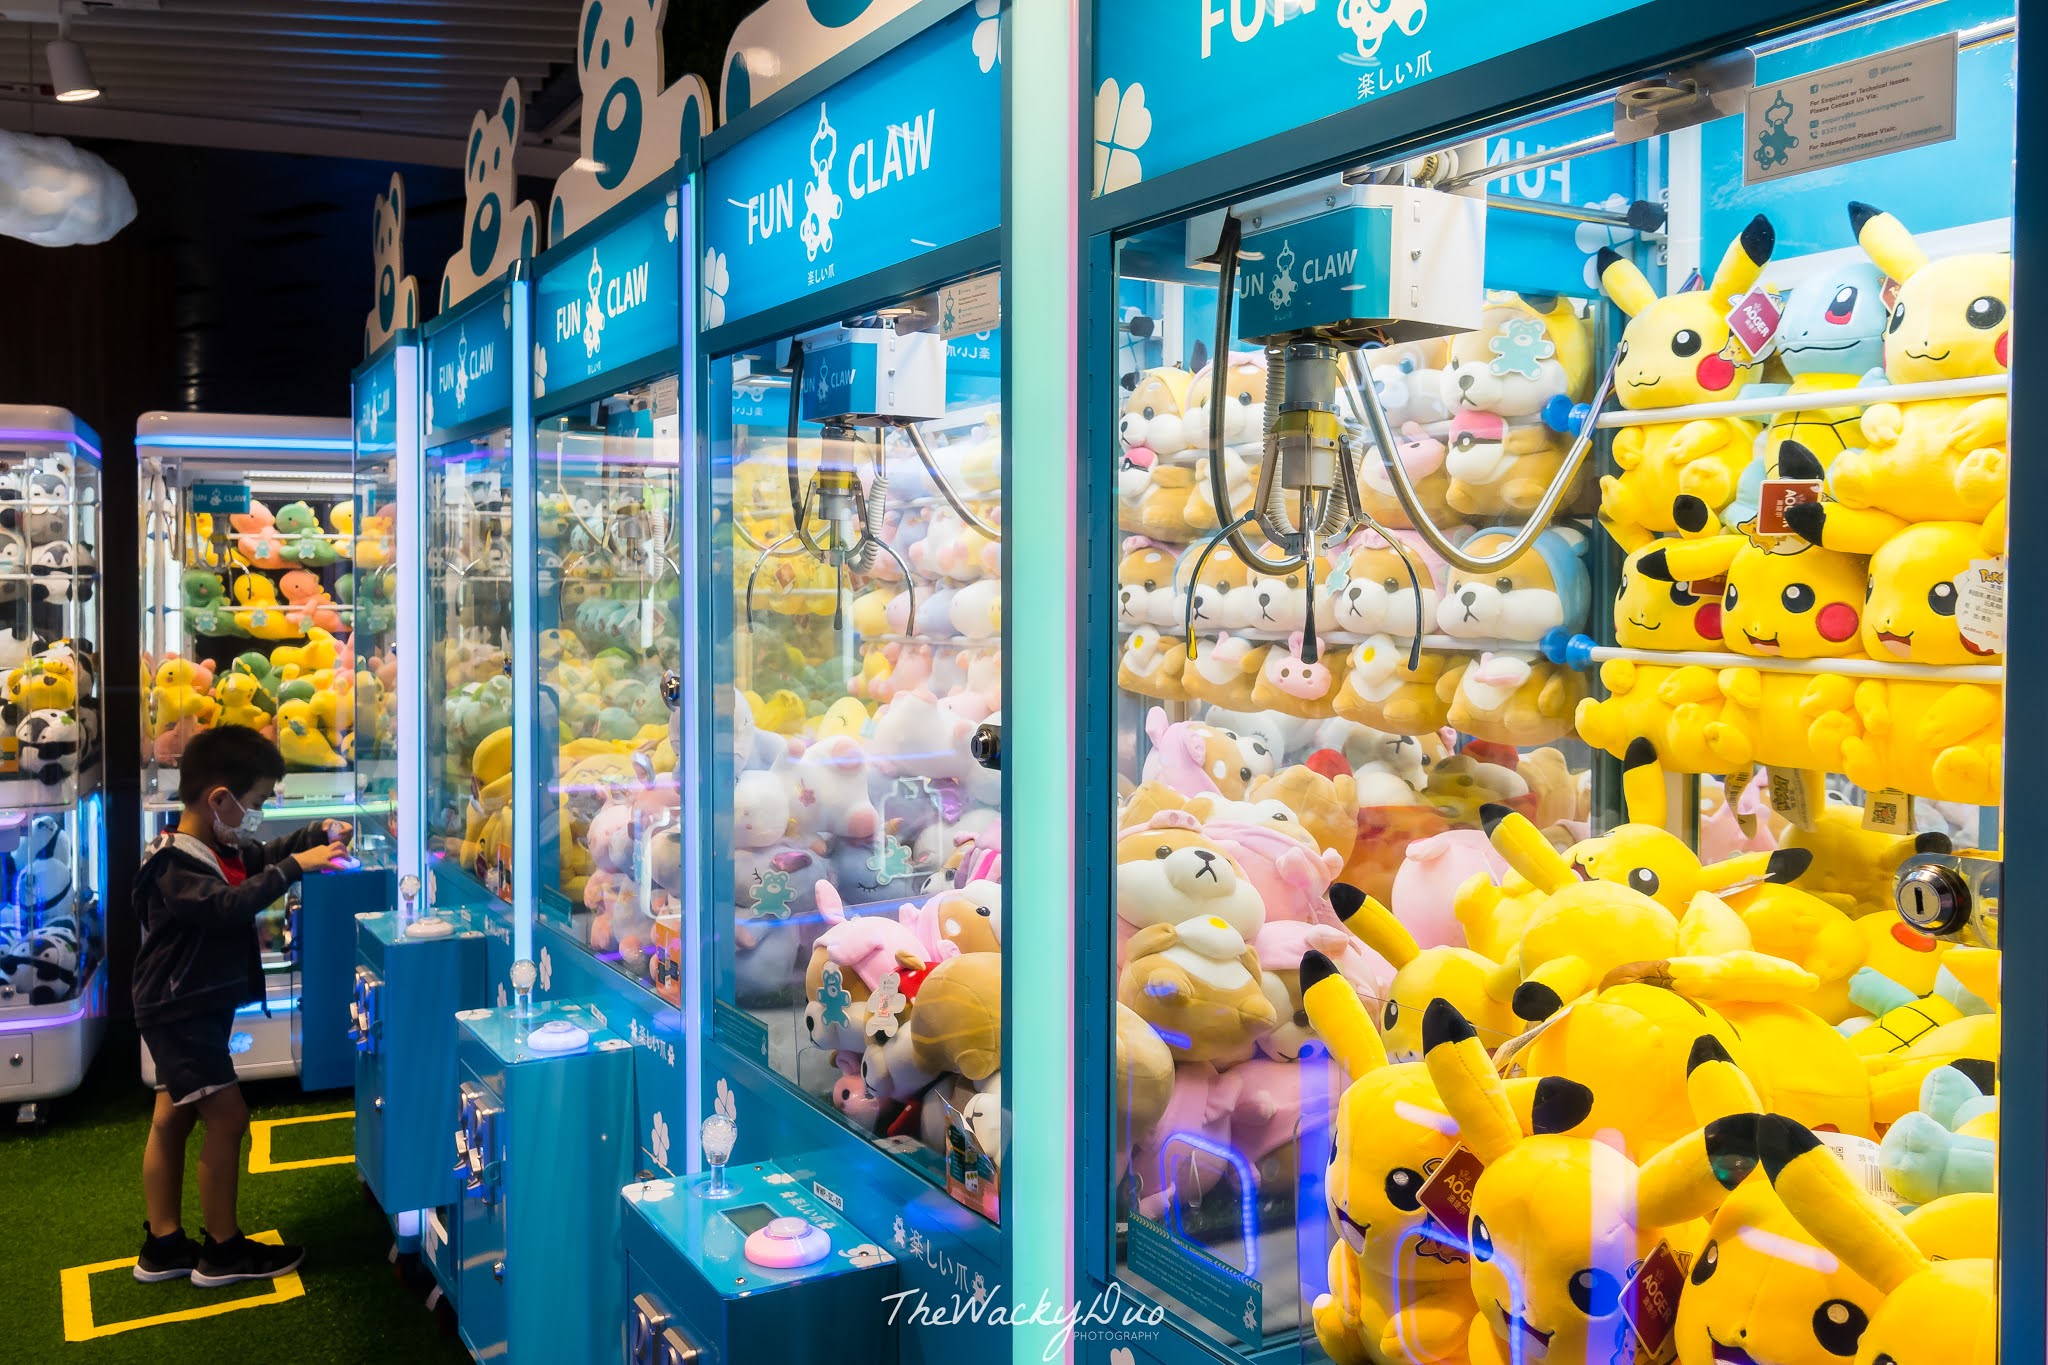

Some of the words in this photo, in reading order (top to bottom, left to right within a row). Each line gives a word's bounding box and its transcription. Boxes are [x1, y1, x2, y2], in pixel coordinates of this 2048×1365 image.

[1357, 50, 1433, 100] 楽しい爪
[1809, 99, 1820, 107] For
[1821, 92, 1849, 104] Enquiries
[1859, 81, 1888, 94] Technical
[1809, 105, 1830, 115] Please
[1830, 99, 1855, 110] Contact
[1808, 143, 1819, 151] For
[1820, 135, 1857, 149] Redemption
[1857, 129, 1879, 139] Please
[748, 178, 793, 245] FUN
[848, 108, 935, 200] CLAW
[807, 263, 835, 287] 楽しい爪
[1240, 272, 1264, 299] UN
[1302, 249, 1358, 284] CLAW
[556, 298, 581, 343] FUN
[606, 261, 650, 318] CLAW
[439, 361, 454, 393] FUN
[469, 342, 494, 380] CLAW
[830, 368, 856, 389] CLAW
[1443, 1174, 1473, 1209] AOG
[909, 1227, 970, 1294] 楽しい爪
